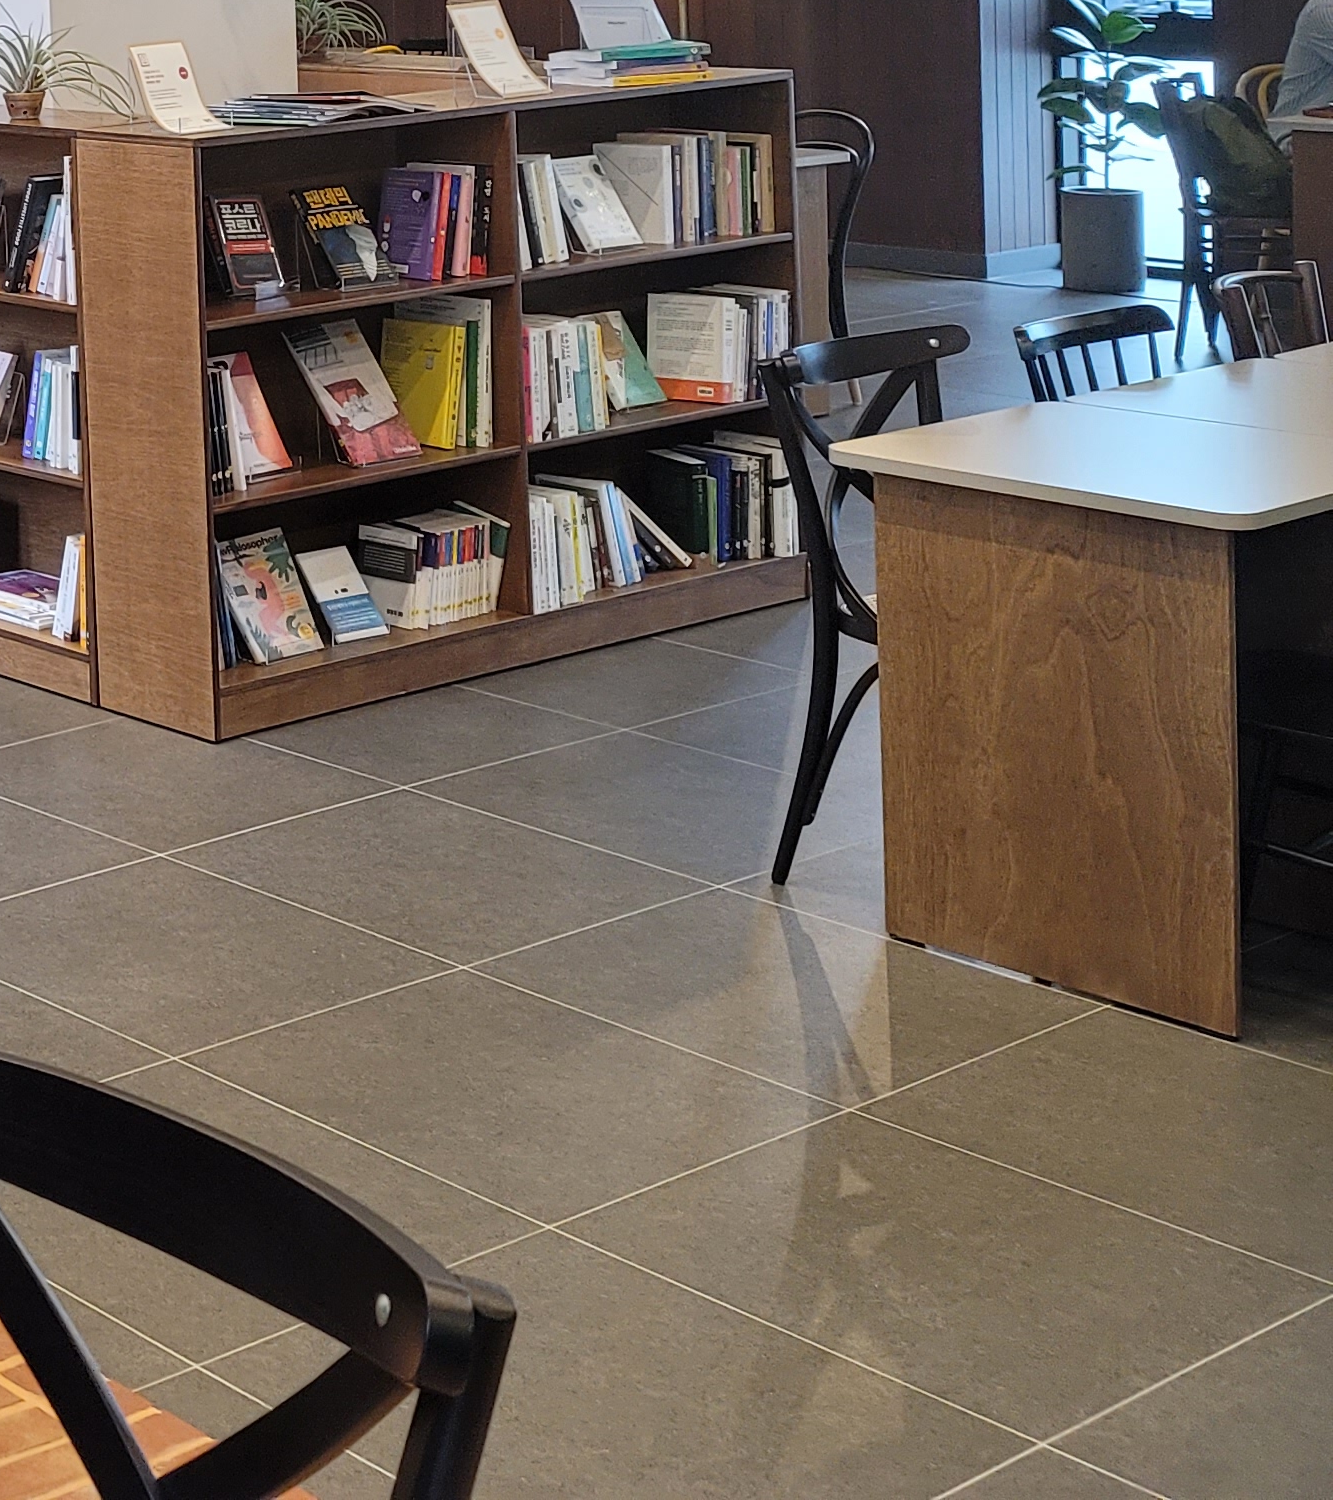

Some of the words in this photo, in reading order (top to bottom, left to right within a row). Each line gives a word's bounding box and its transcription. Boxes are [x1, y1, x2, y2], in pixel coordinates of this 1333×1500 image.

[303, 186, 353, 209] 팬데믹
[219, 204, 258, 218] 포스트
[307, 209, 370, 231] PANDEMIC
[223, 219, 262, 233] 코로나
